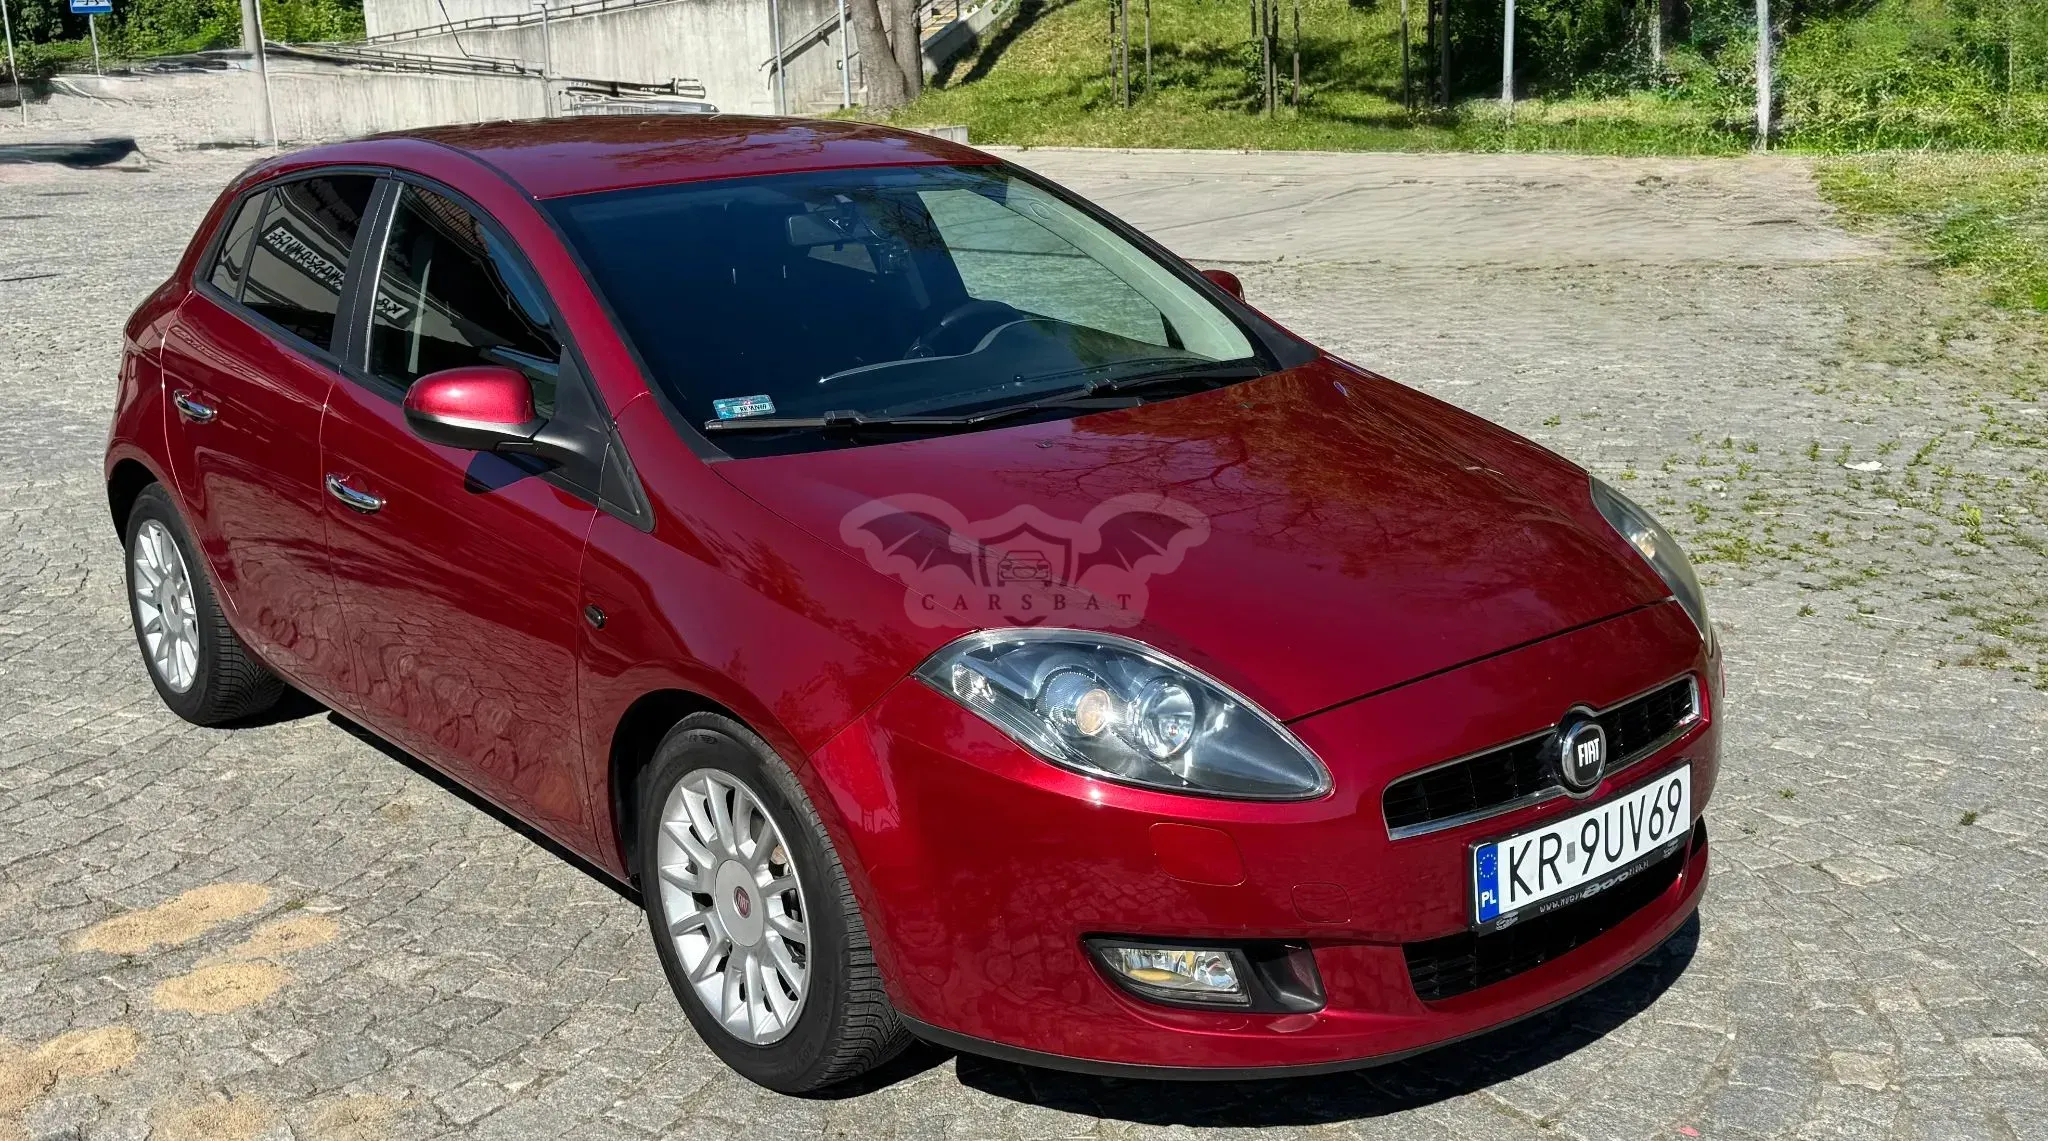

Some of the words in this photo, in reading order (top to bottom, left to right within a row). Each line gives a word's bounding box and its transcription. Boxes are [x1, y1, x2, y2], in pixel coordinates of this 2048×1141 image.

[1577, 737, 1600, 768] FIAT
[1509, 832, 1563, 903] KR
[1580, 778, 1682, 876] 9UV69
[1481, 890, 1497, 907] PL
